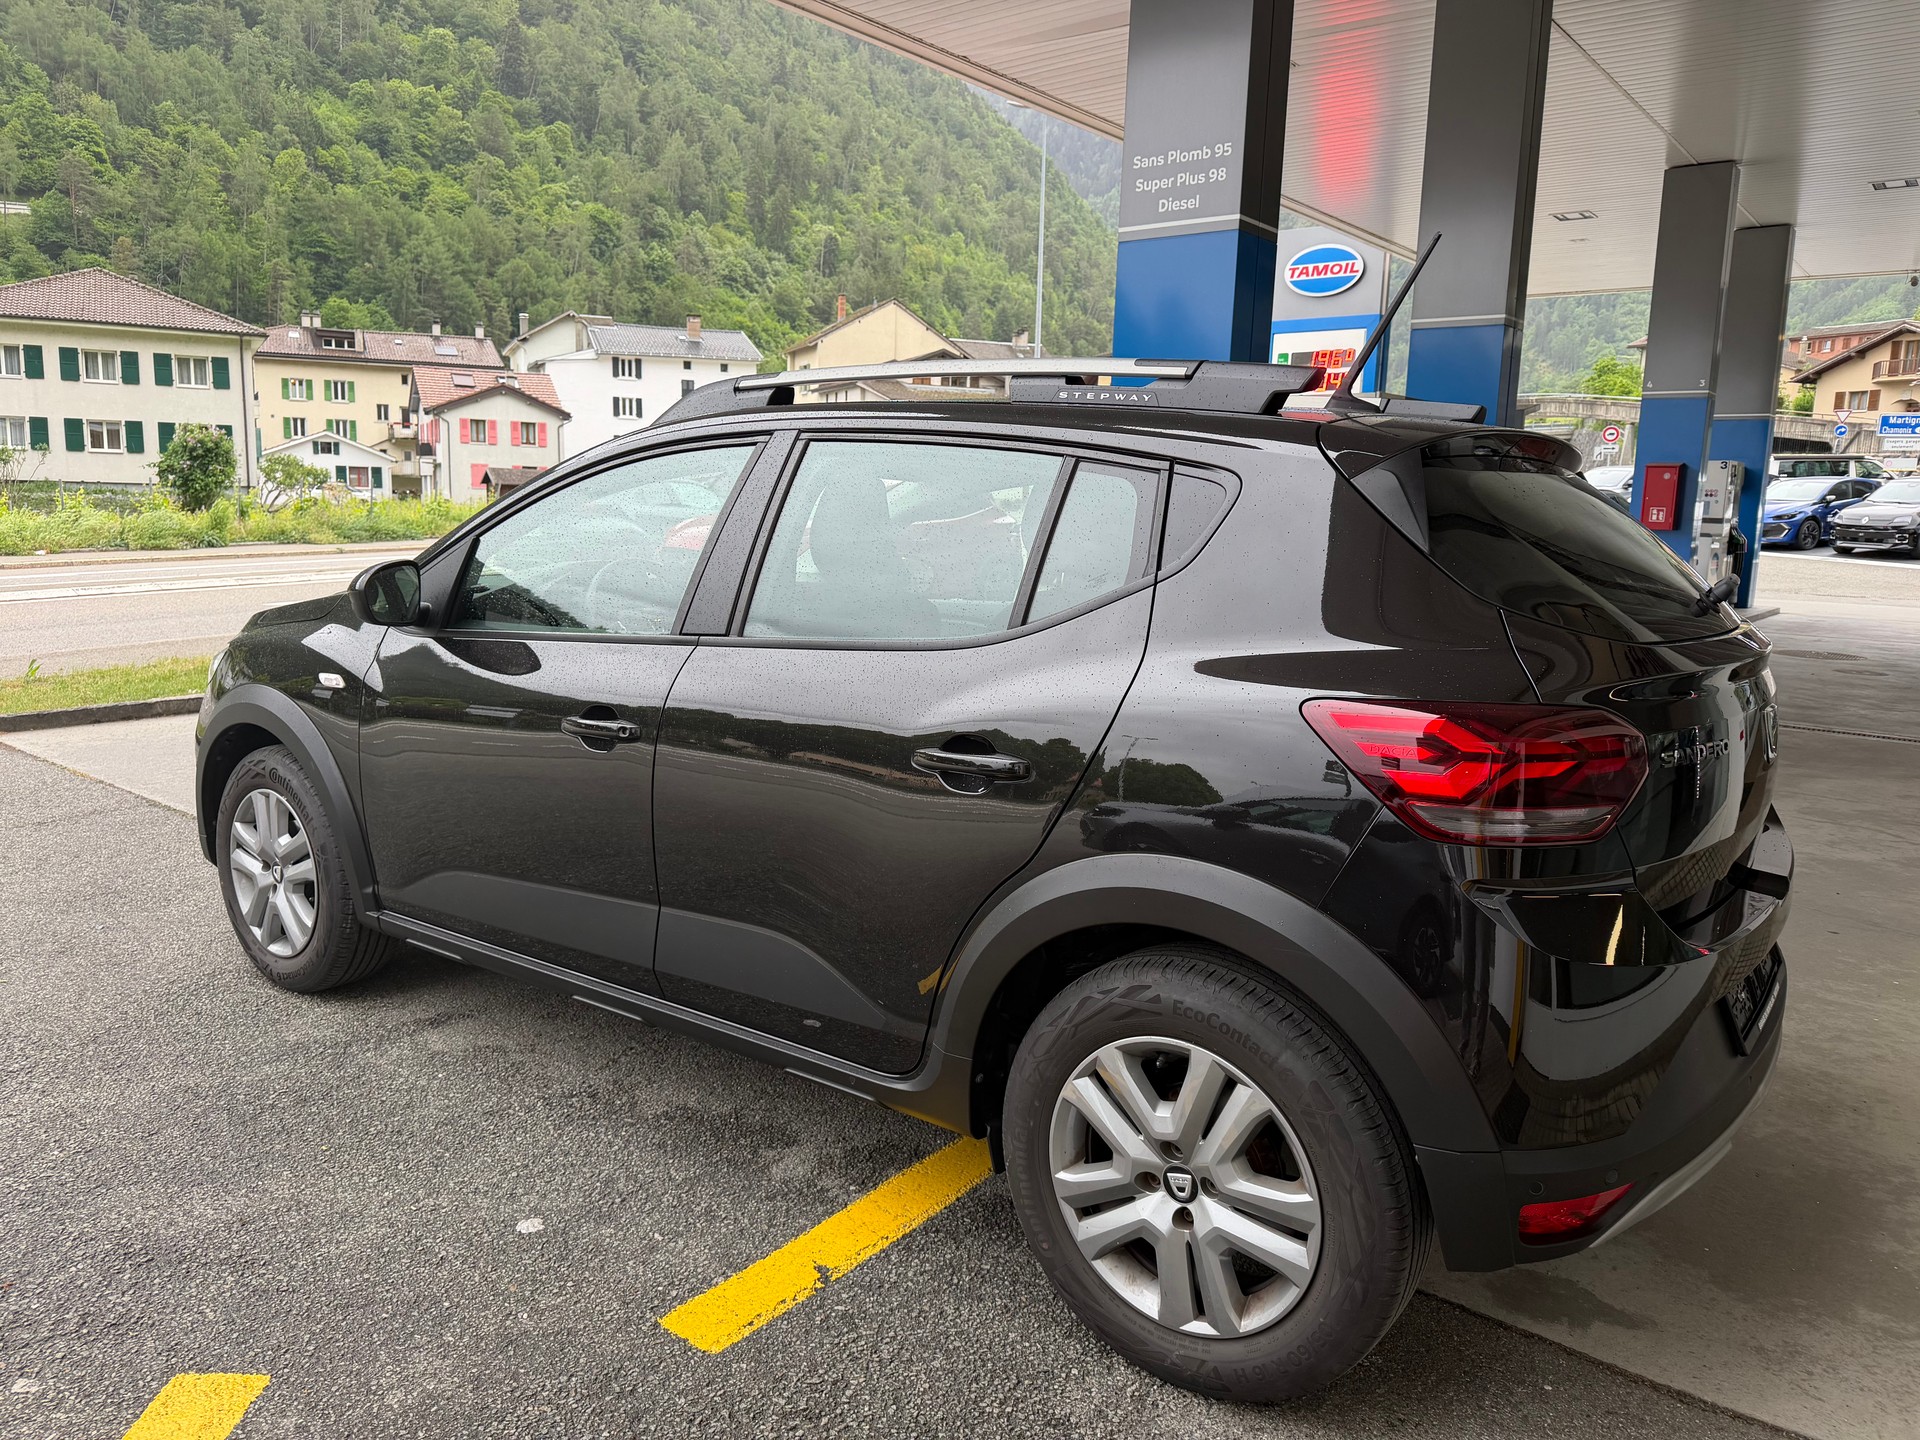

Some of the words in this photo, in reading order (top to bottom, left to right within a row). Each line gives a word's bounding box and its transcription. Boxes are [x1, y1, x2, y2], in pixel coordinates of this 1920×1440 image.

[1133, 155, 1164, 169] Sans
[1167, 145, 1211, 164] Plomb
[1214, 142, 1232, 157] 95
[1135, 177, 1174, 194] Super
[1177, 171, 1205, 187] Plus
[1208, 167, 1227, 182] 98
[1158, 194, 1200, 213] Diesel
[1288, 261, 1360, 279] TAMOIL
[1646, 380, 1653, 388] 4
[1699, 379, 1706, 387] 3
[1059, 391, 1152, 402] STEPWAY
[1720, 461, 1728, 470] 3
[1370, 745, 1417, 758] DACIA
[1660, 738, 1730, 769] SANDERO
[268, 767, 314, 827] Continental
[1173, 999, 1280, 1071] EcoContact
